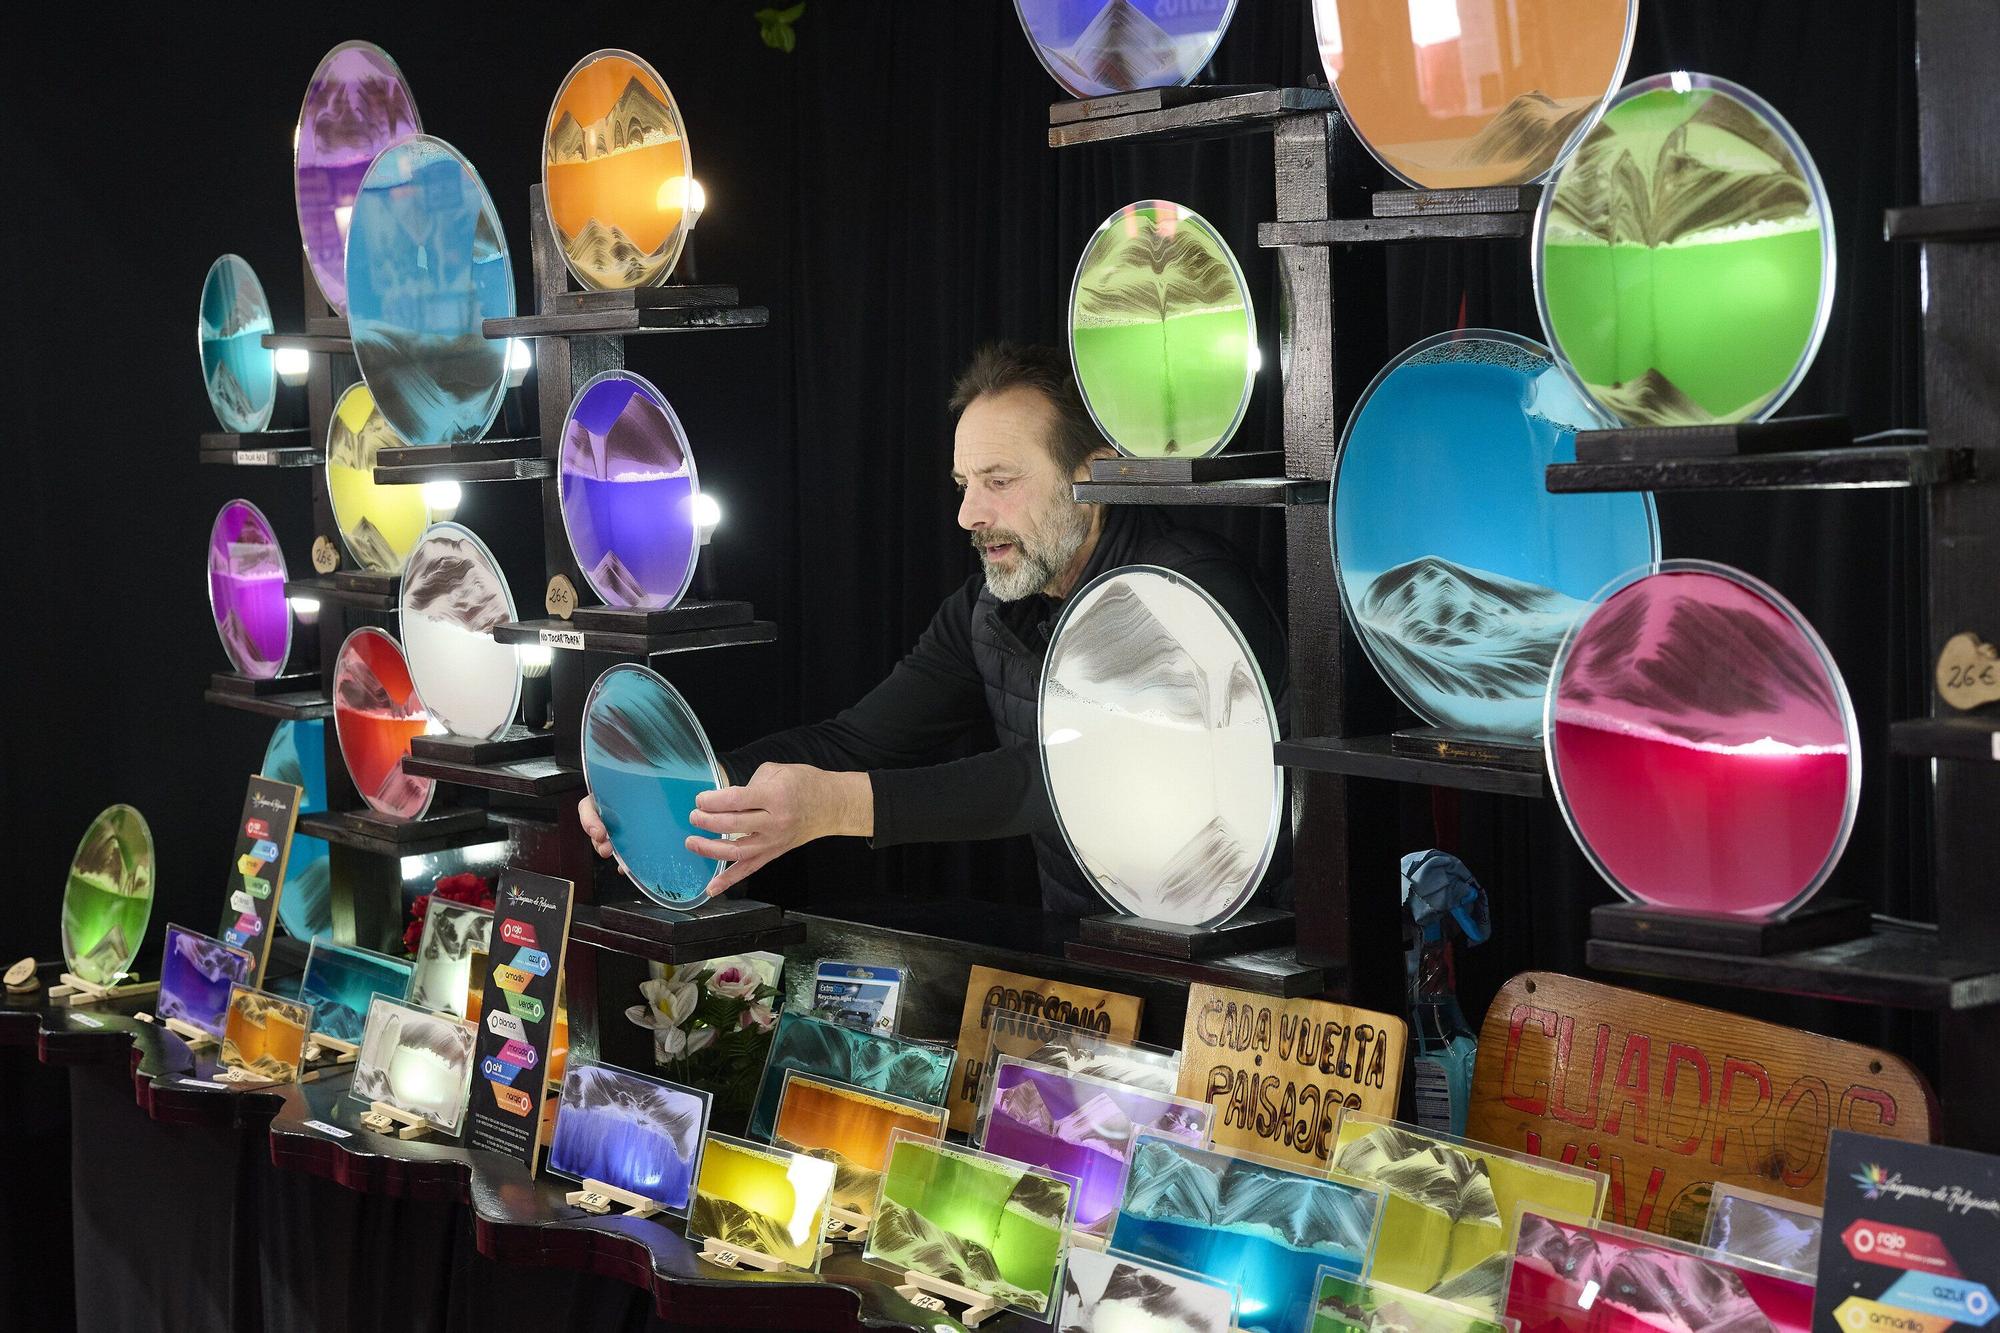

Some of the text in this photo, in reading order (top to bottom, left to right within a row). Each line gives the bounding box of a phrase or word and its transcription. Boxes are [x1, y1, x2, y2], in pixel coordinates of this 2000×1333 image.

[549, 588, 568, 604] 26€
[540, 633, 548, 642] NO
[548, 633, 563, 644] TOCAR
[1947, 664, 1997, 688] 26€
[511, 924, 523, 935] rojo
[528, 954, 540, 964] azul
[505, 972, 525, 983] amarillo
[1195, 1000, 1387, 1090] CADA VUELTA
[1876, 1231, 1906, 1249] rojo
[1932, 1286, 1966, 1303] azul
[1869, 1311, 1924, 1332] amarillo
